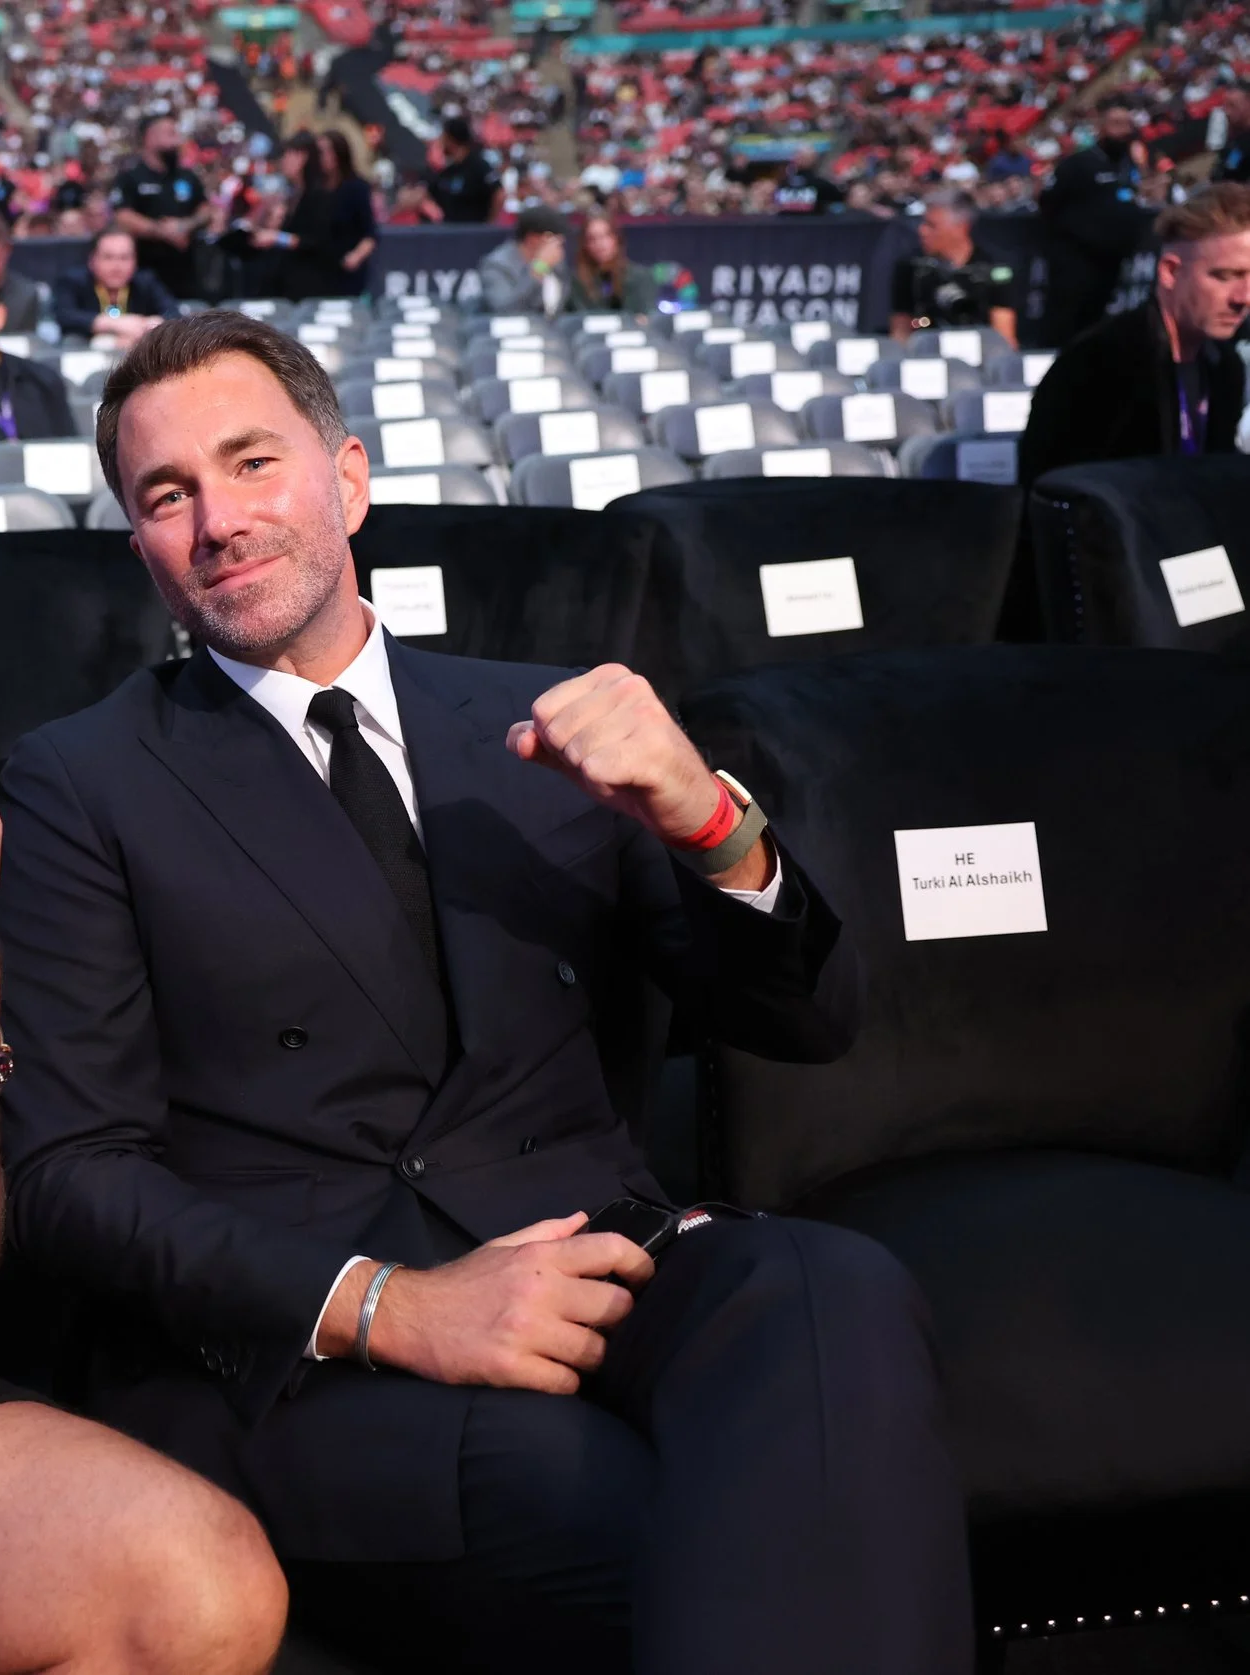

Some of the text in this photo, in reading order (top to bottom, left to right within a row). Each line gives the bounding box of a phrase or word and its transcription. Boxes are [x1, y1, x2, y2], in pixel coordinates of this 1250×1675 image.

[384, 268, 483, 302] RIYA
[711, 264, 862, 297] RIYADH
[954, 852, 975, 866] HE
[912, 870, 1034, 891] Turki Al Alshaikh
